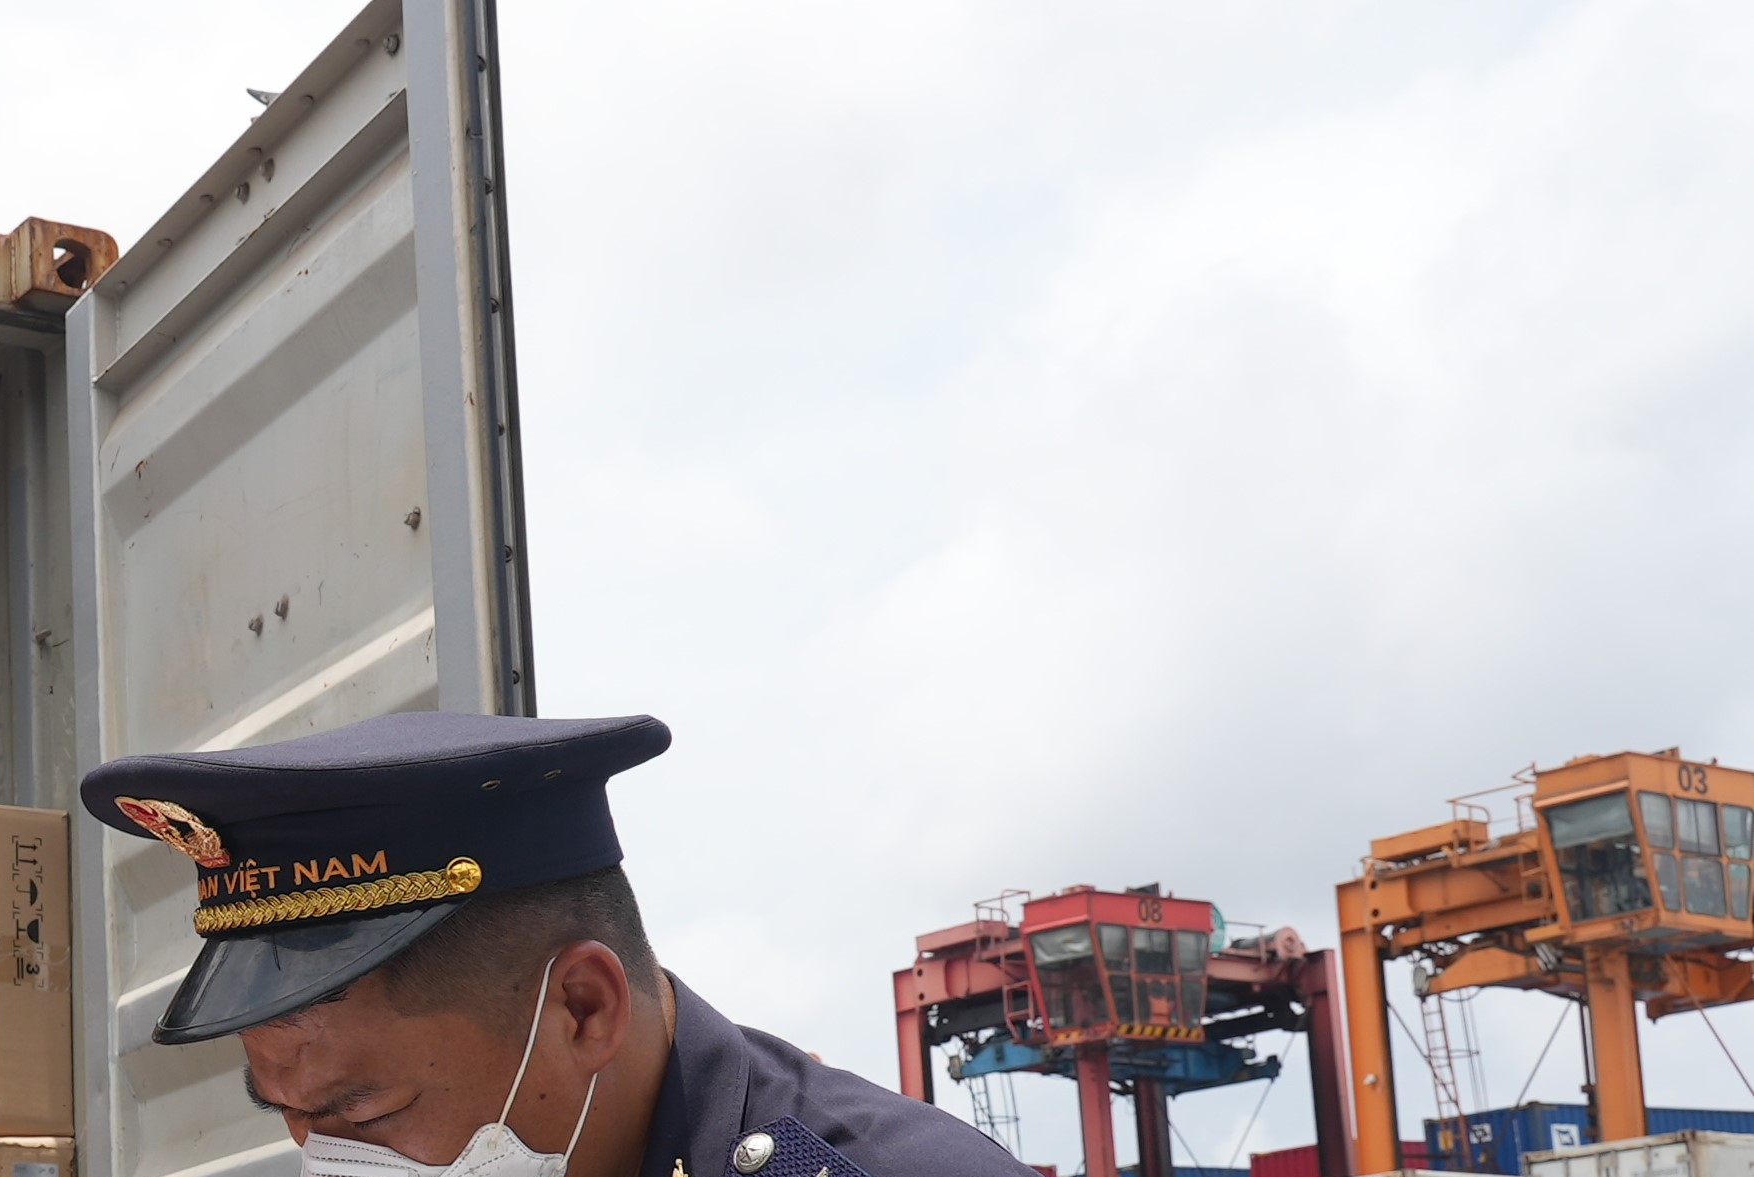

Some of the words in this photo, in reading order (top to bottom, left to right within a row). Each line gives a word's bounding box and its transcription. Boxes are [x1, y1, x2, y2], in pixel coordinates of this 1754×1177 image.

[1677, 764, 1709, 795] 03
[224, 858, 280, 899] VIỆT
[293, 850, 388, 887] NAM
[1137, 898, 1163, 924] 08
[25, 963, 40, 975] 3
